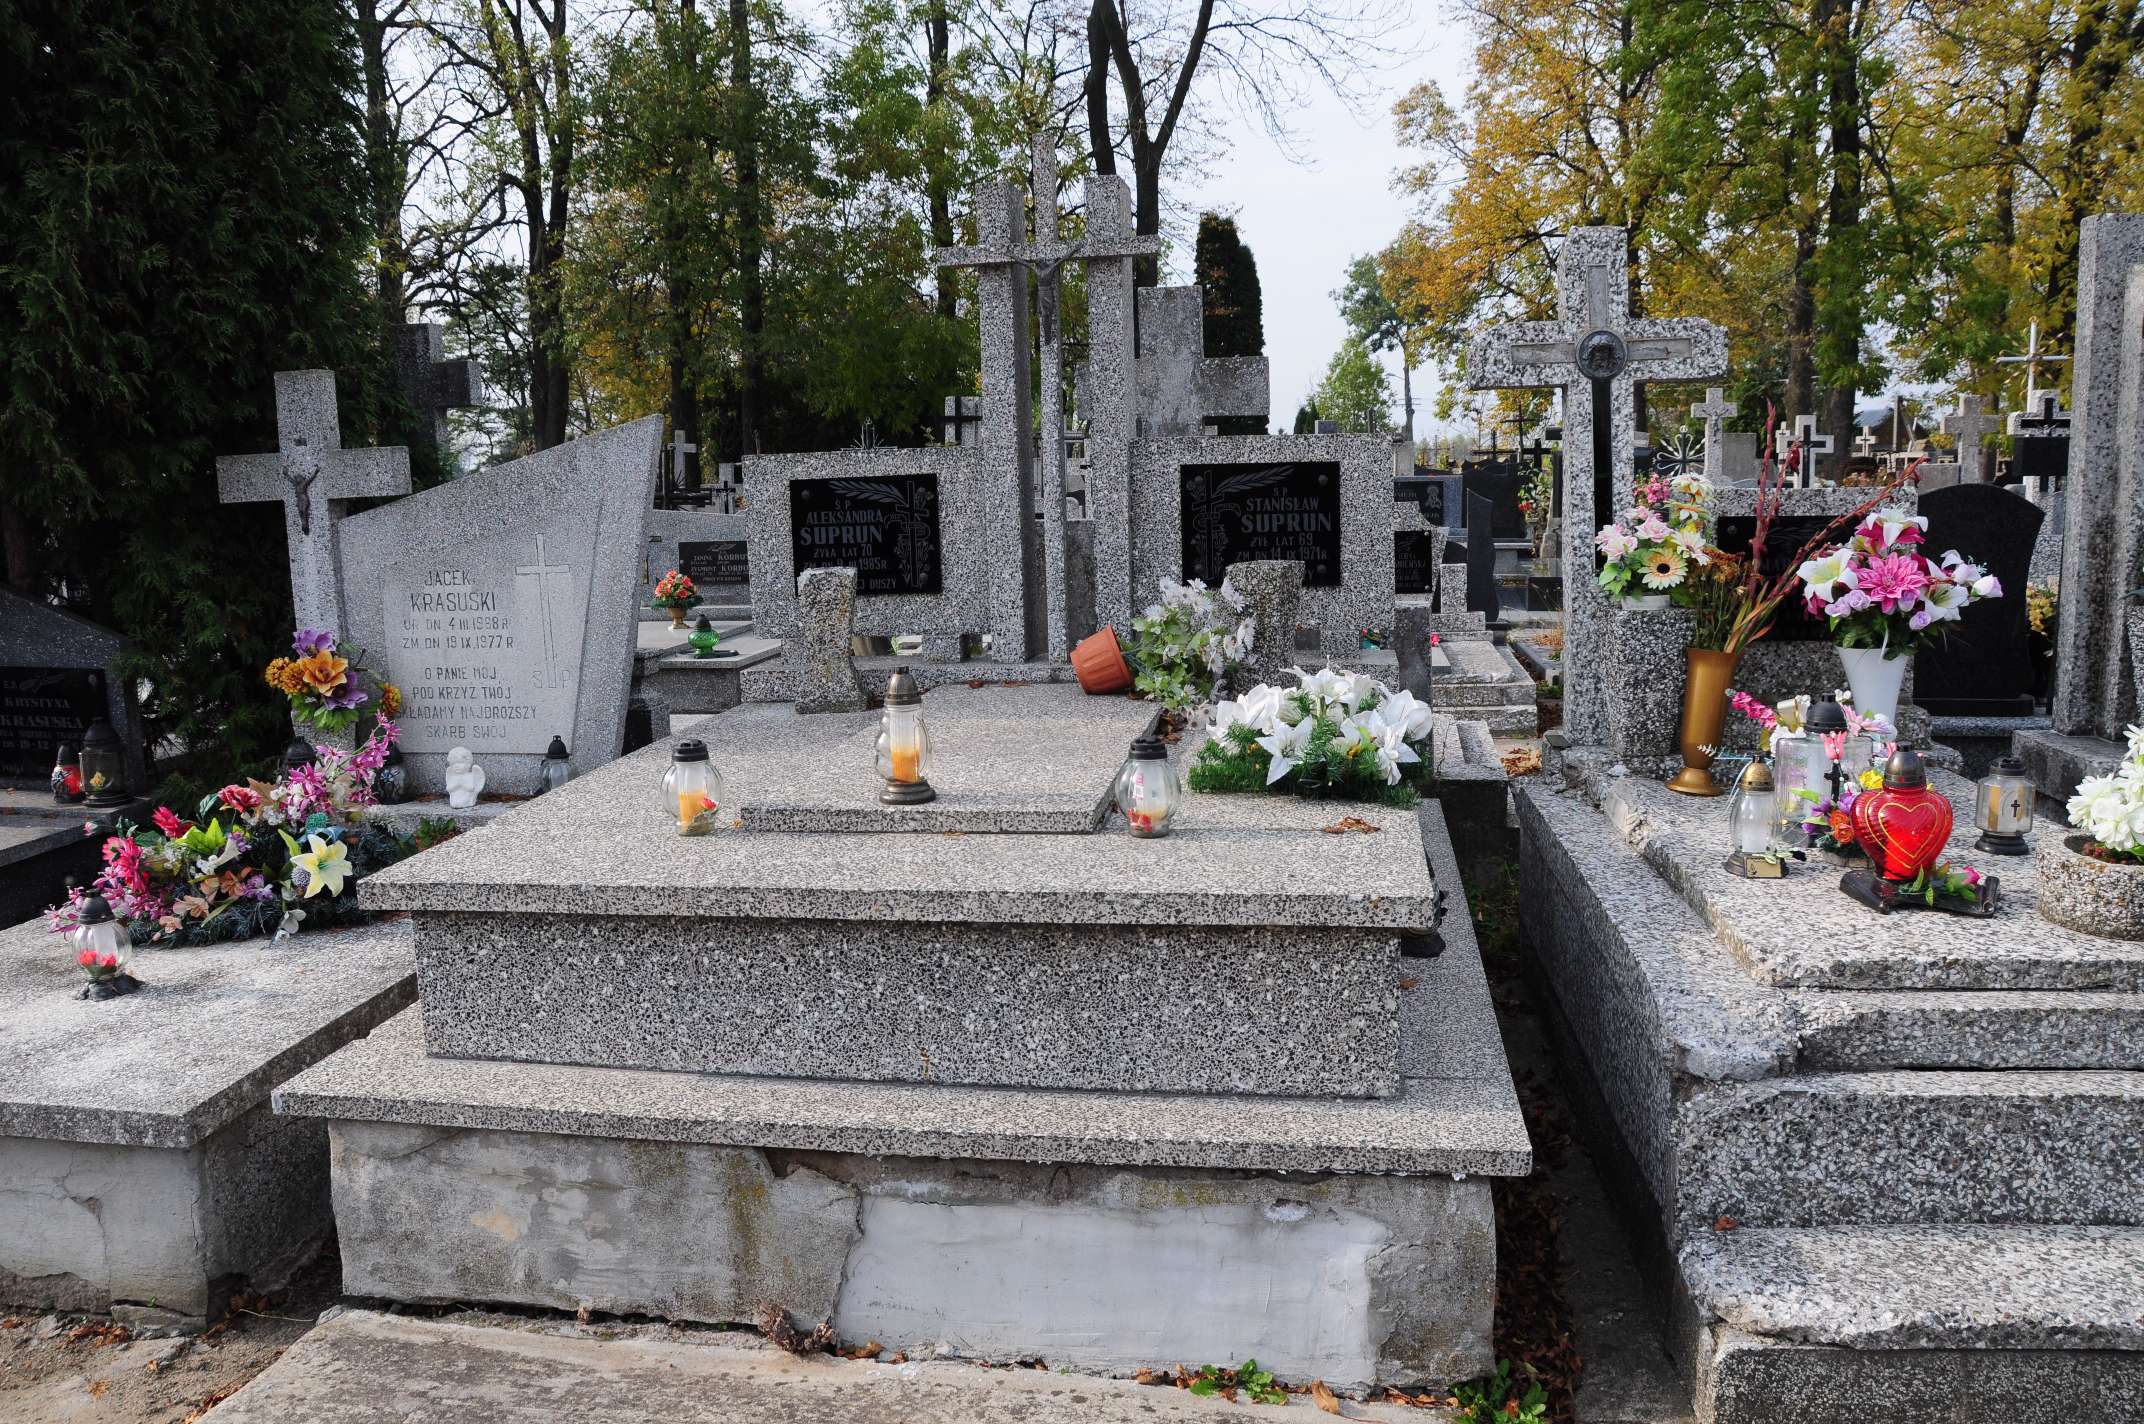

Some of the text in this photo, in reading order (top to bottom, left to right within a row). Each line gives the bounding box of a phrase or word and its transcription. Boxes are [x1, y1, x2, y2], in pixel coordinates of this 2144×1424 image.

[1246, 496, 1320, 512] STANISŁAW
[806, 508, 884, 525] ALEKSANDRA
[1240, 512, 1332, 533] SUPRUN
[800, 525, 882, 546] SUPRUN
[1275, 536, 1295, 546] LAT
[1298, 532, 1313, 546] 69
[842, 547, 857, 558] LAT
[861, 543, 873, 557] 70
[424, 569, 472, 587] JACEK
[869, 577, 897, 590] DUSZY
[410, 591, 497, 612] KRASUSKI
[424, 667, 432, 680] O
[437, 666, 467, 680] PANIE
[412, 686, 434, 700] POD
[4, 696, 71, 709] KRYSTYNA
[426, 725, 467, 739] SKARB
